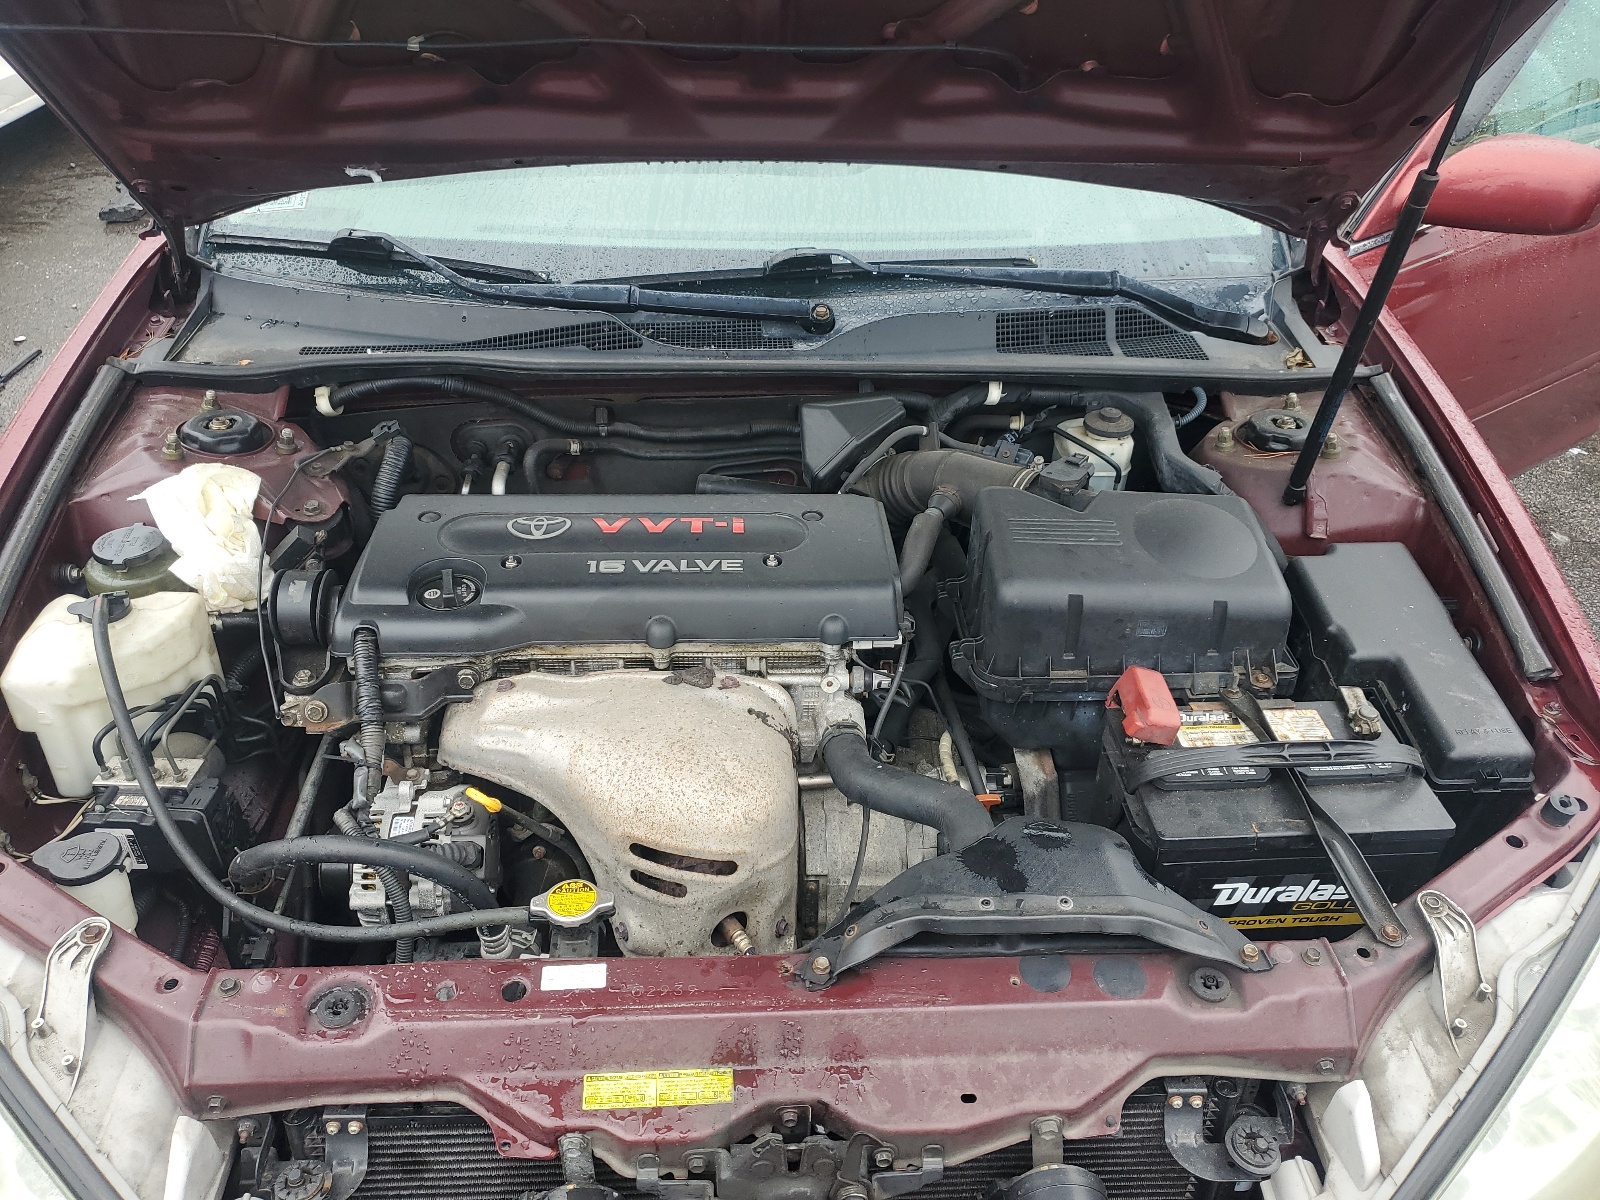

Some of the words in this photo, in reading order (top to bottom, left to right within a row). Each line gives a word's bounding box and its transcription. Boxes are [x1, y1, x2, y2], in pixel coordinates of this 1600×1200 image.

[592, 517, 745, 534] VVT-i
[586, 559, 626, 574] 16
[632, 559, 744, 574] VALVE
[1212, 879, 1349, 906] Duralas
[1292, 915, 1340, 924] TOUGH
